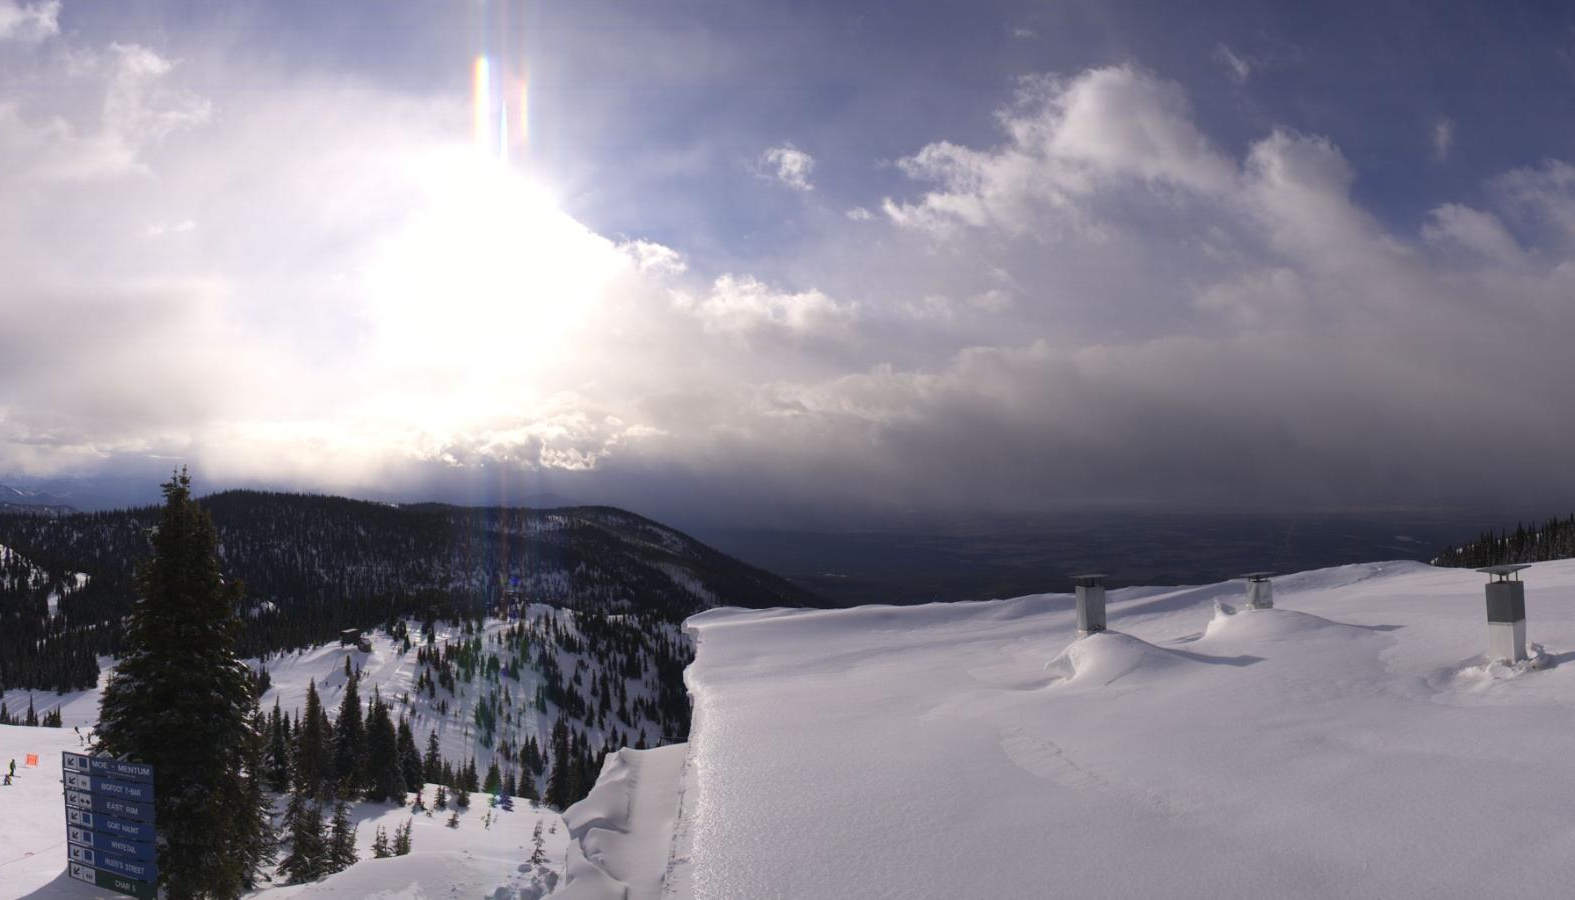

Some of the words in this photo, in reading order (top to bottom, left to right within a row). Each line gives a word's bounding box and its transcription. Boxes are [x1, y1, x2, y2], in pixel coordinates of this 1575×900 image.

[91, 760, 108, 769] MOE
[117, 764, 150, 776] MENTUM
[106, 801, 123, 812] EAST
